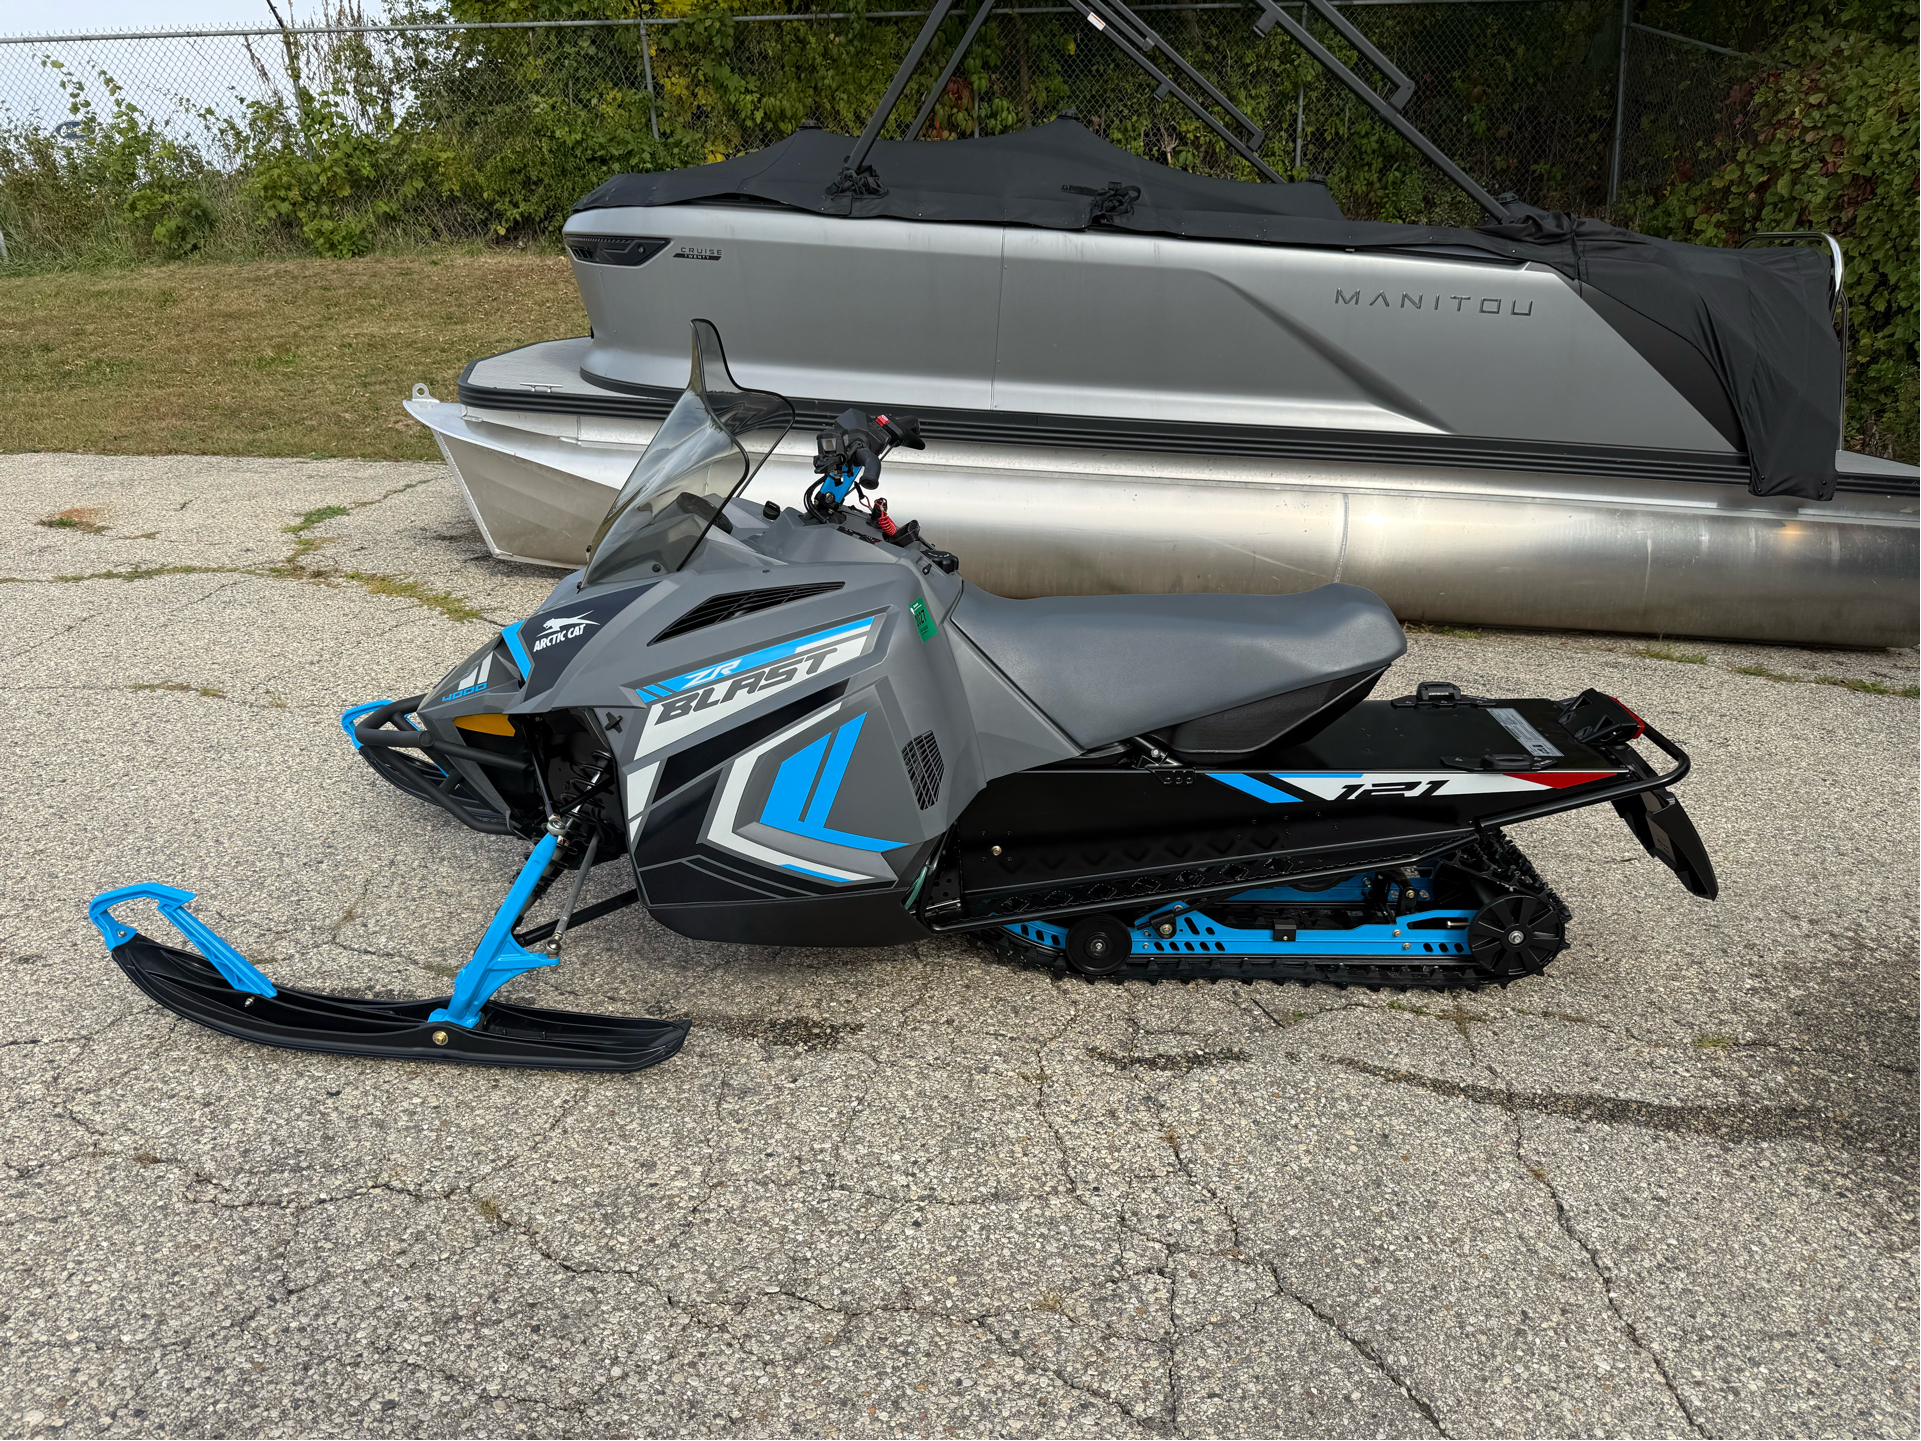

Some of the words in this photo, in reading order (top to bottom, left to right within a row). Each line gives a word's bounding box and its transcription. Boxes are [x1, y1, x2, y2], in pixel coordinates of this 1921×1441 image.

[680, 247, 722, 255] CRUISE
[1334, 287, 1534, 317] MANITOU
[533, 630, 566, 652] ARCTIC
[567, 624, 586, 639] CAT
[653, 647, 838, 727] BLAST
[679, 658, 743, 690] ZR
[441, 682, 488, 702] 4000
[1333, 779, 1451, 801] 121
